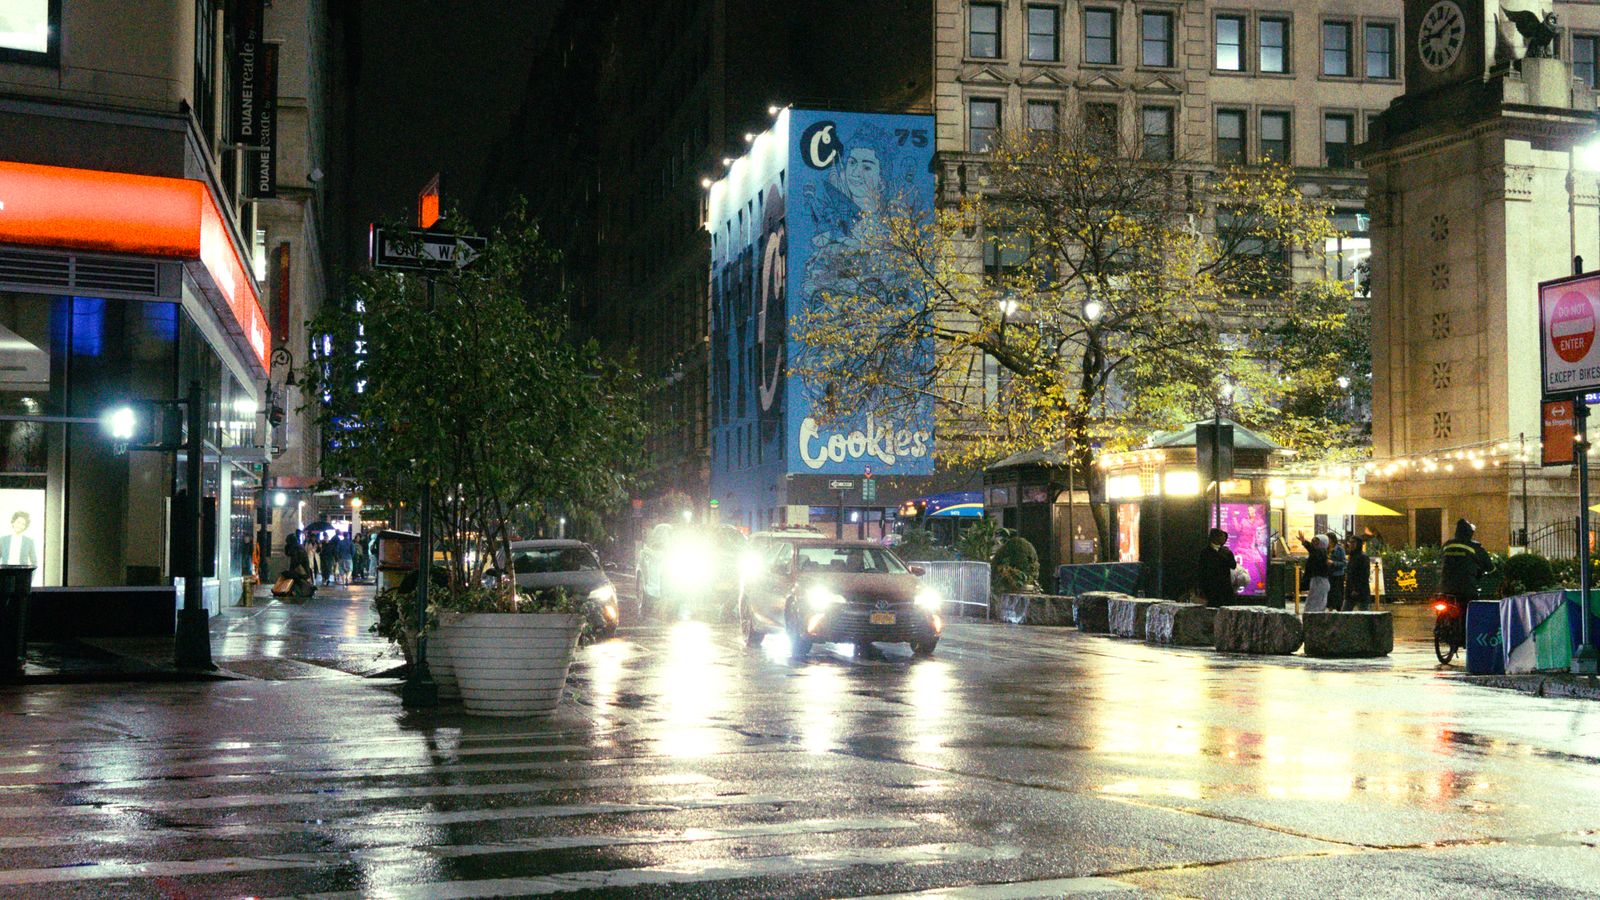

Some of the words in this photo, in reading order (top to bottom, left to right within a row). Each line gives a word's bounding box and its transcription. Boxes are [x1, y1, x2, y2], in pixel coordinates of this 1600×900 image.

[894, 128, 930, 148] 75
[1558, 306, 1569, 317] DO
[1571, 303, 1586, 314] NOT
[1560, 338, 1584, 351] ENTER
[1550, 370, 1576, 384] EXCEPT
[1579, 366, 1600, 382] BIKES
[798, 410, 931, 470] Cookies
